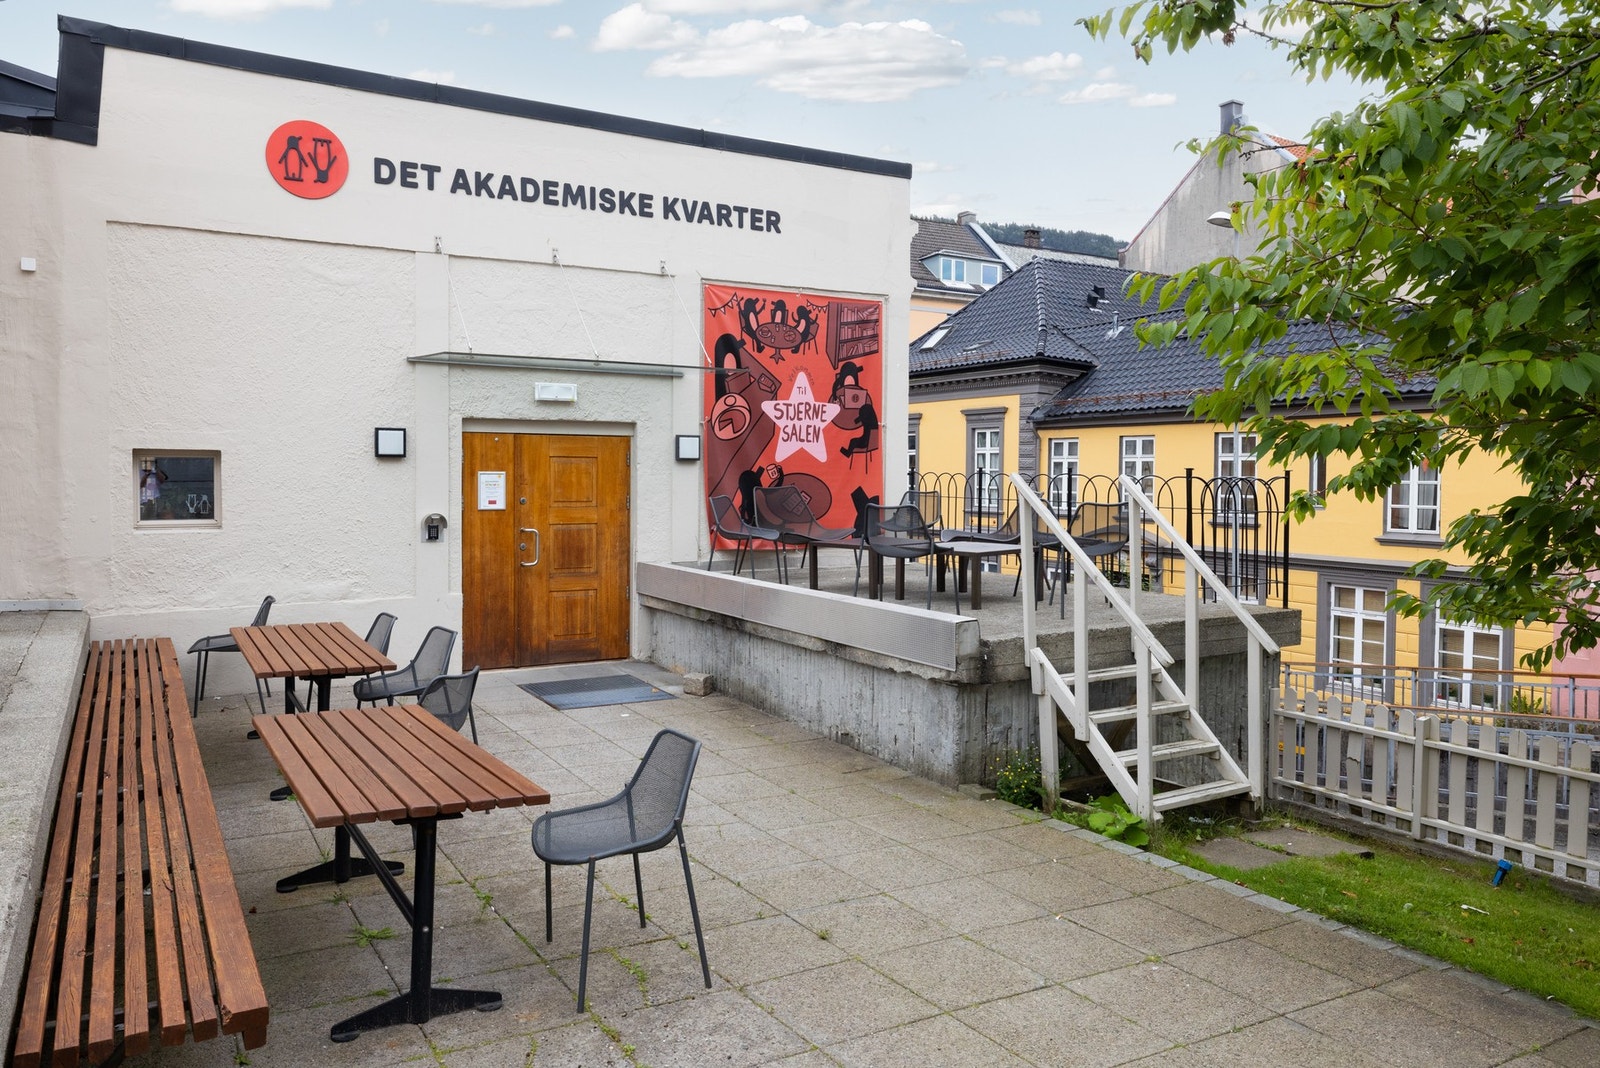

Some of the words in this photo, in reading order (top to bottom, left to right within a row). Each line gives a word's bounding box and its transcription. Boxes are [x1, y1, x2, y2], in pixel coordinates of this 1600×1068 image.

[374, 157, 442, 191] DET
[450, 168, 654, 218] AKADEMISKE
[663, 197, 782, 234] KVARTER
[797, 386, 807, 395] Til
[773, 402, 828, 422] STJERNE
[781, 424, 821, 443] SALEN
